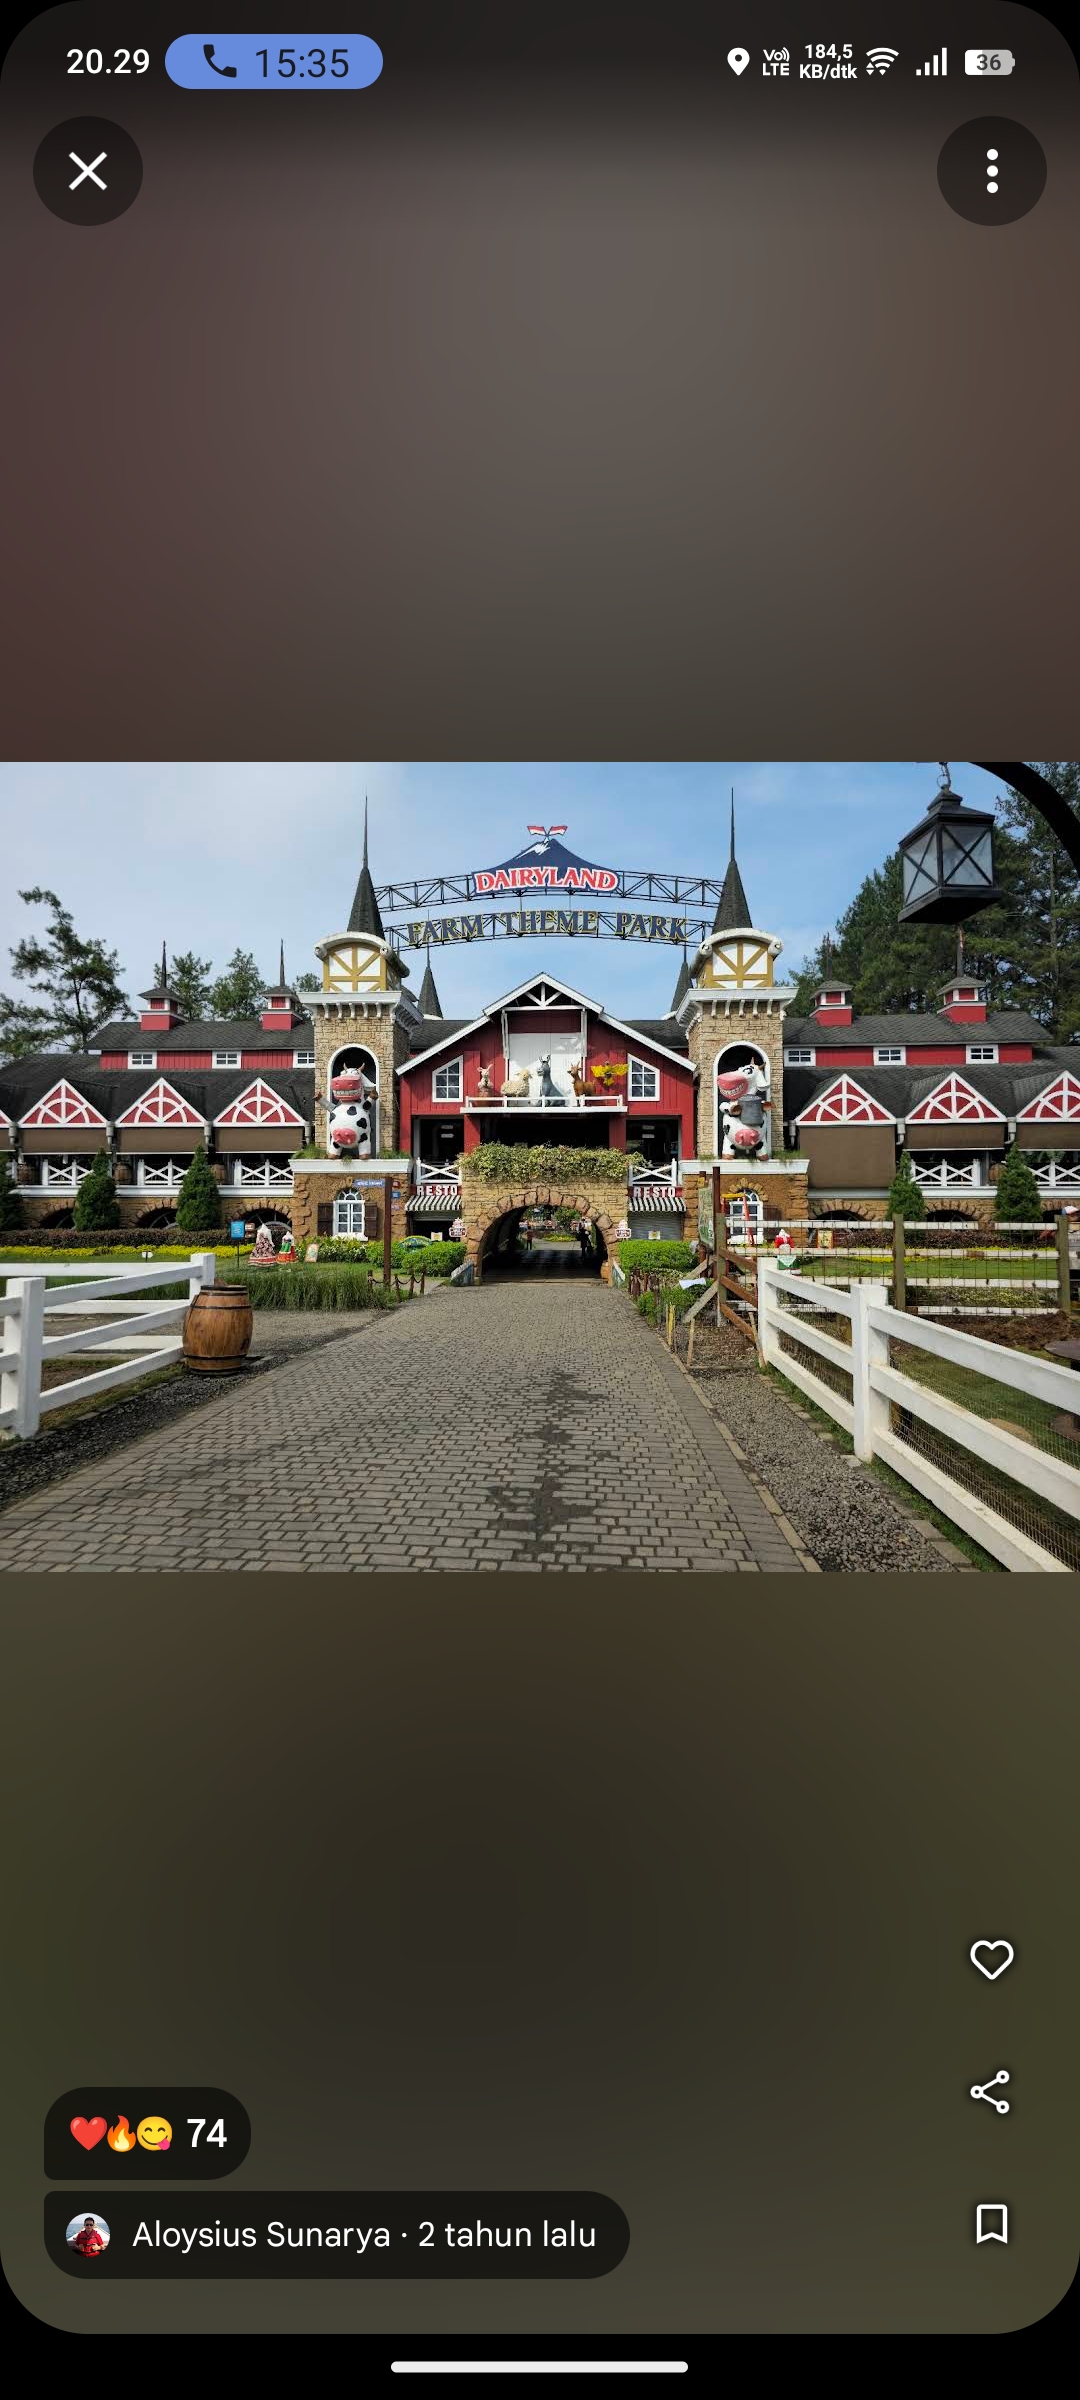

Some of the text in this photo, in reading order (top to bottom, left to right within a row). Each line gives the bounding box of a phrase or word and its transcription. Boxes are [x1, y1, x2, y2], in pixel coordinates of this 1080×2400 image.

[474, 866, 620, 893] DAIRYLAND
[407, 910, 690, 946] FARM THEME PARK
[416, 1184, 459, 1197] RESTO
[633, 1186, 677, 1199] RESTO
